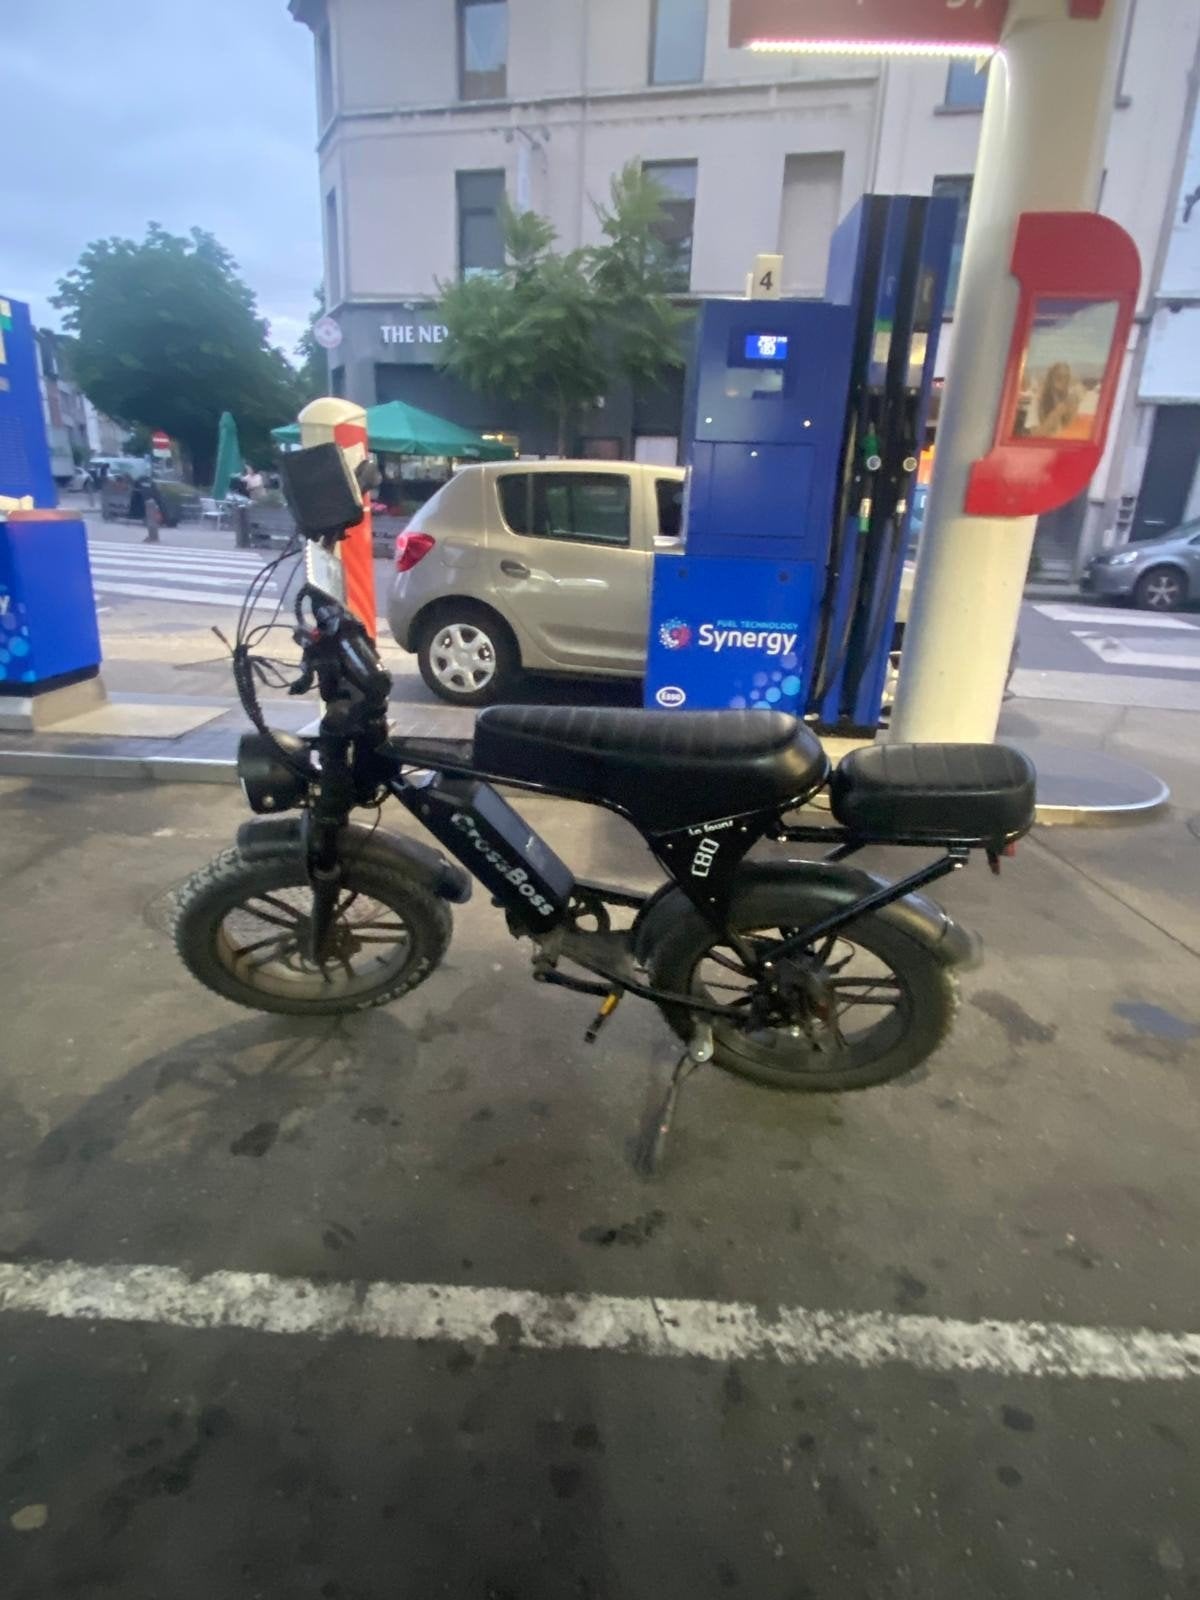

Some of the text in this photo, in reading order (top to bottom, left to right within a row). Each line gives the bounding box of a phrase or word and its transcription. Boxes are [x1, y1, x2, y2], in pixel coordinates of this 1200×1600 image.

[759, 271, 773, 290] 4
[381, 325, 415, 343] THE
[717, 619, 798, 630] FUEL TECHNOLOGY
[698, 624, 797, 655] Synergy
